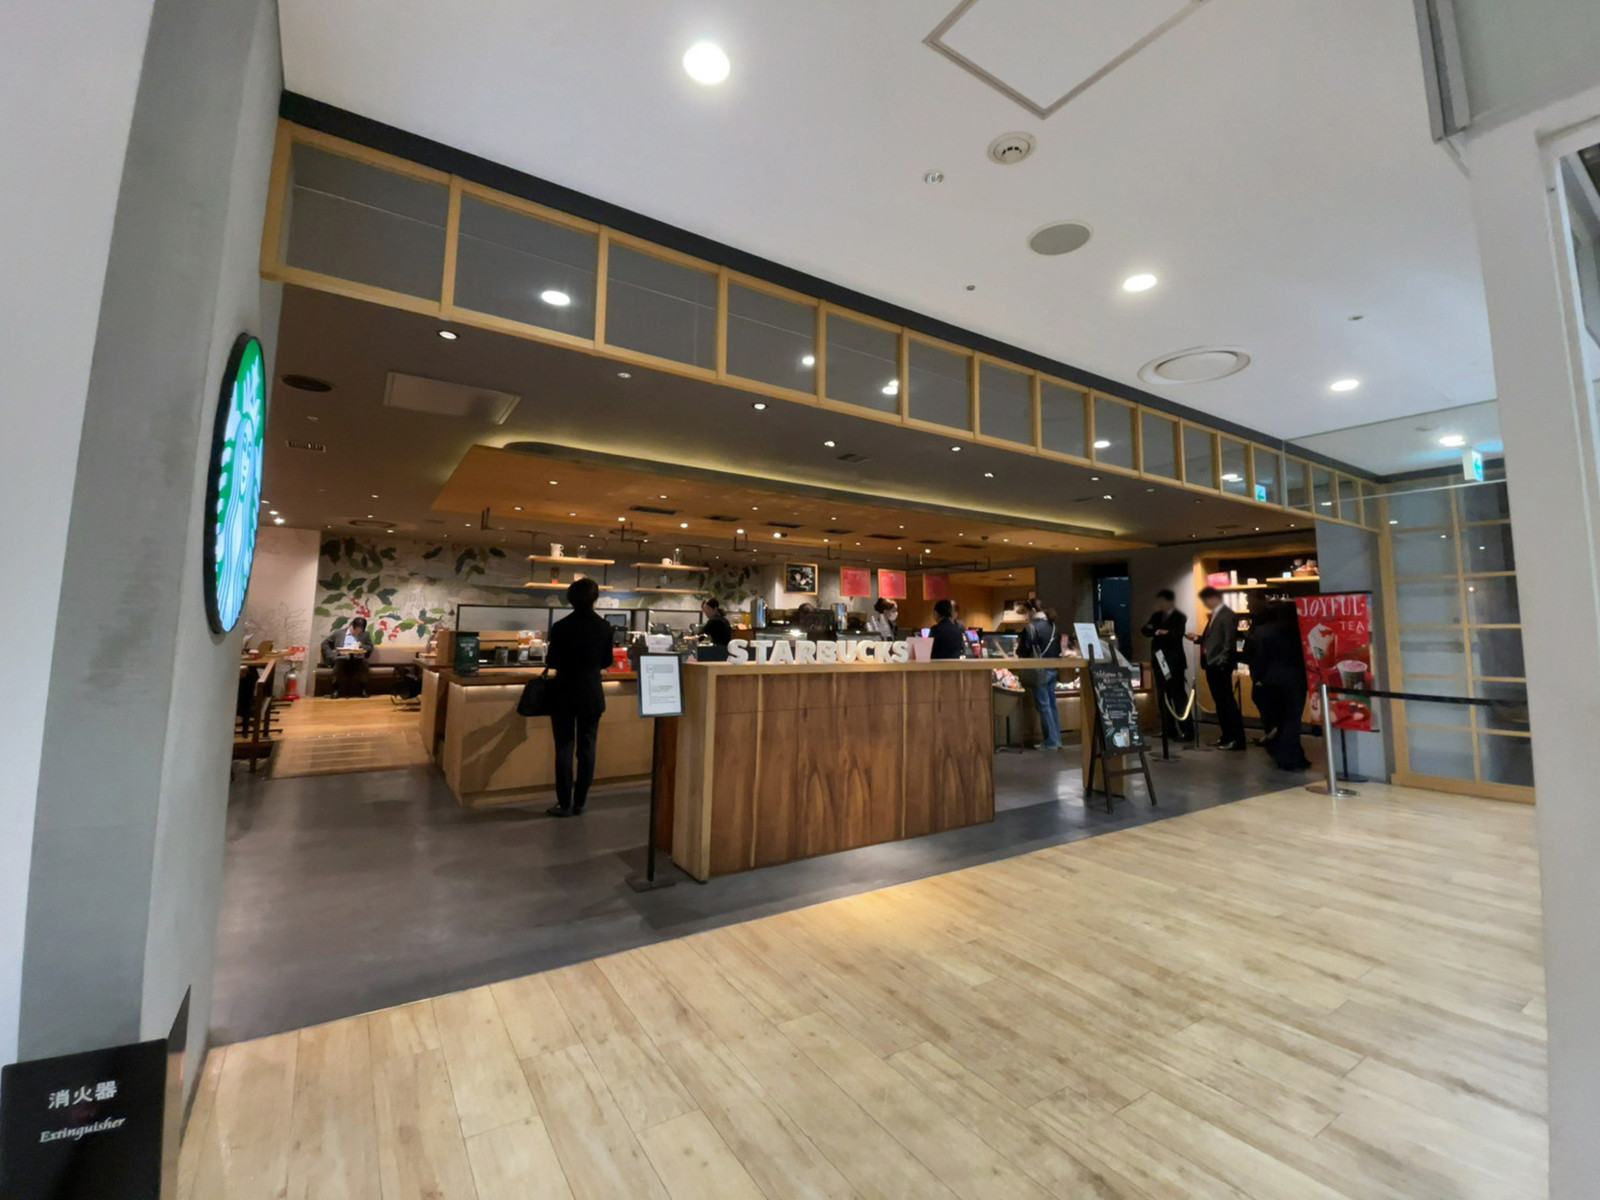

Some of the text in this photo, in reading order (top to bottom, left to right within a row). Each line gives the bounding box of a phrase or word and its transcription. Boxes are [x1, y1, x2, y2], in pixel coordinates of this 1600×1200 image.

[1297, 595, 1363, 617] JOYFUL
[1340, 621, 1365, 632] TEA
[727, 639, 909, 665] STARBUCKS
[48, 1080, 118, 1110] 消火器
[39, 1116, 126, 1143] Extinguisher
